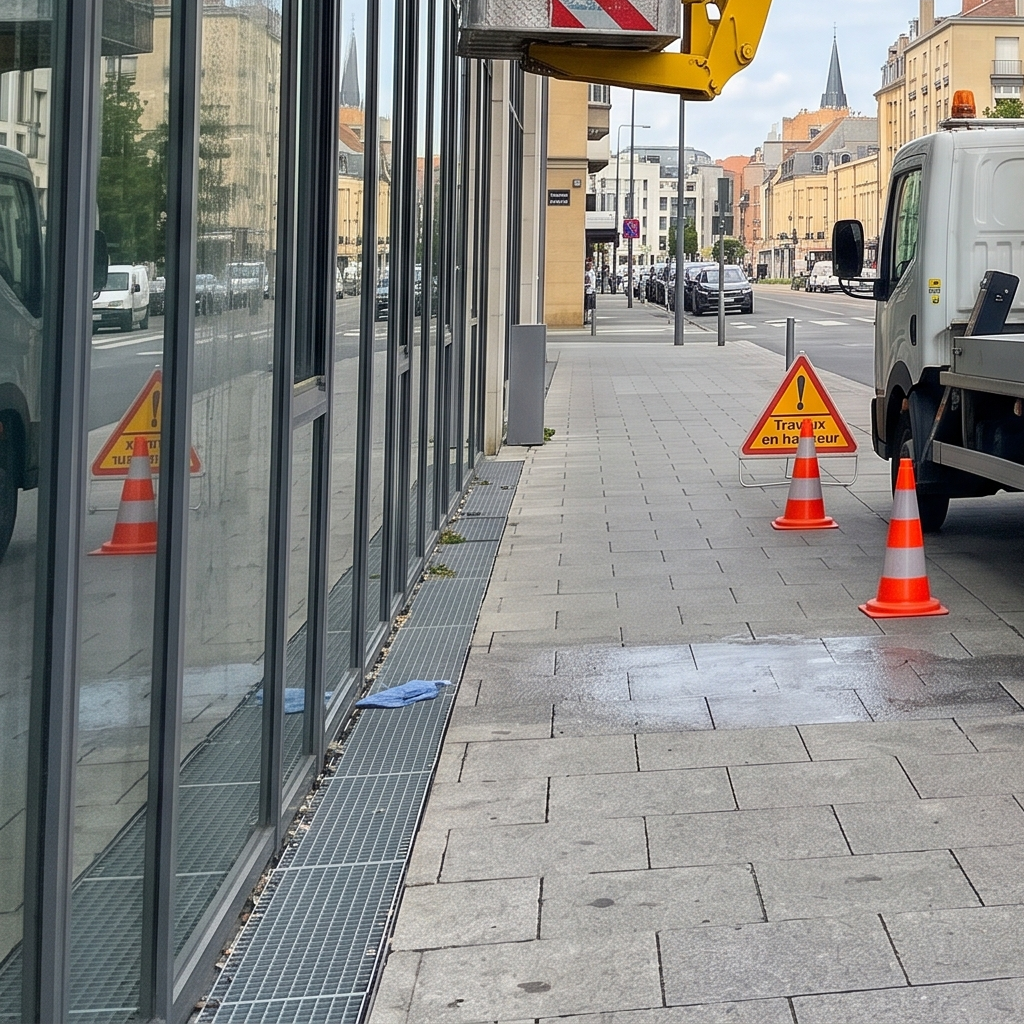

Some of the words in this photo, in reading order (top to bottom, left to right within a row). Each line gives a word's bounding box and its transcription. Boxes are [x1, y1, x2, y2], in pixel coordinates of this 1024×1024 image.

[774, 419, 826, 431] Travx
[761, 435, 779, 445] en
[783, 433, 840, 445] haeur
